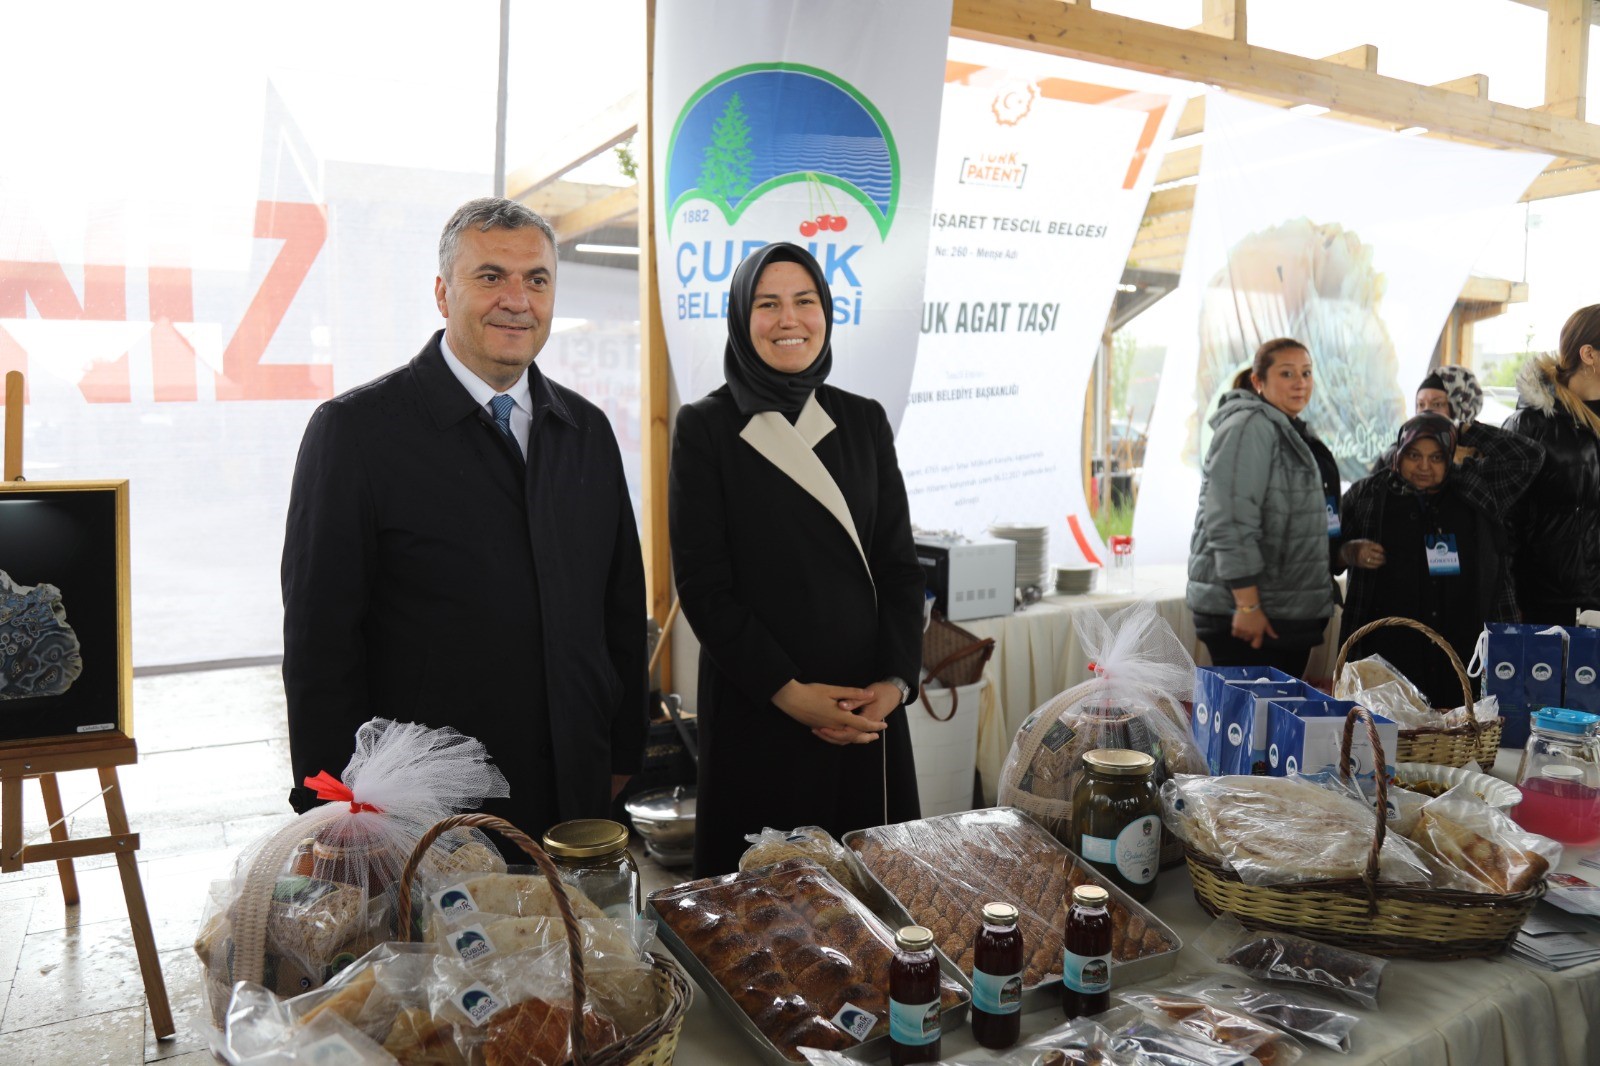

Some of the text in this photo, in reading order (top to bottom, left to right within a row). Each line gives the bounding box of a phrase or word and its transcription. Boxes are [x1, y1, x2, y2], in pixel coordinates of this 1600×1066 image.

[966, 164, 1022, 183] PATENT
[682, 209, 709, 223] 1882
[951, 246, 968, 258] 260
[954, 302, 1012, 334] AGAT
[1016, 302, 1061, 335] TAŞI
